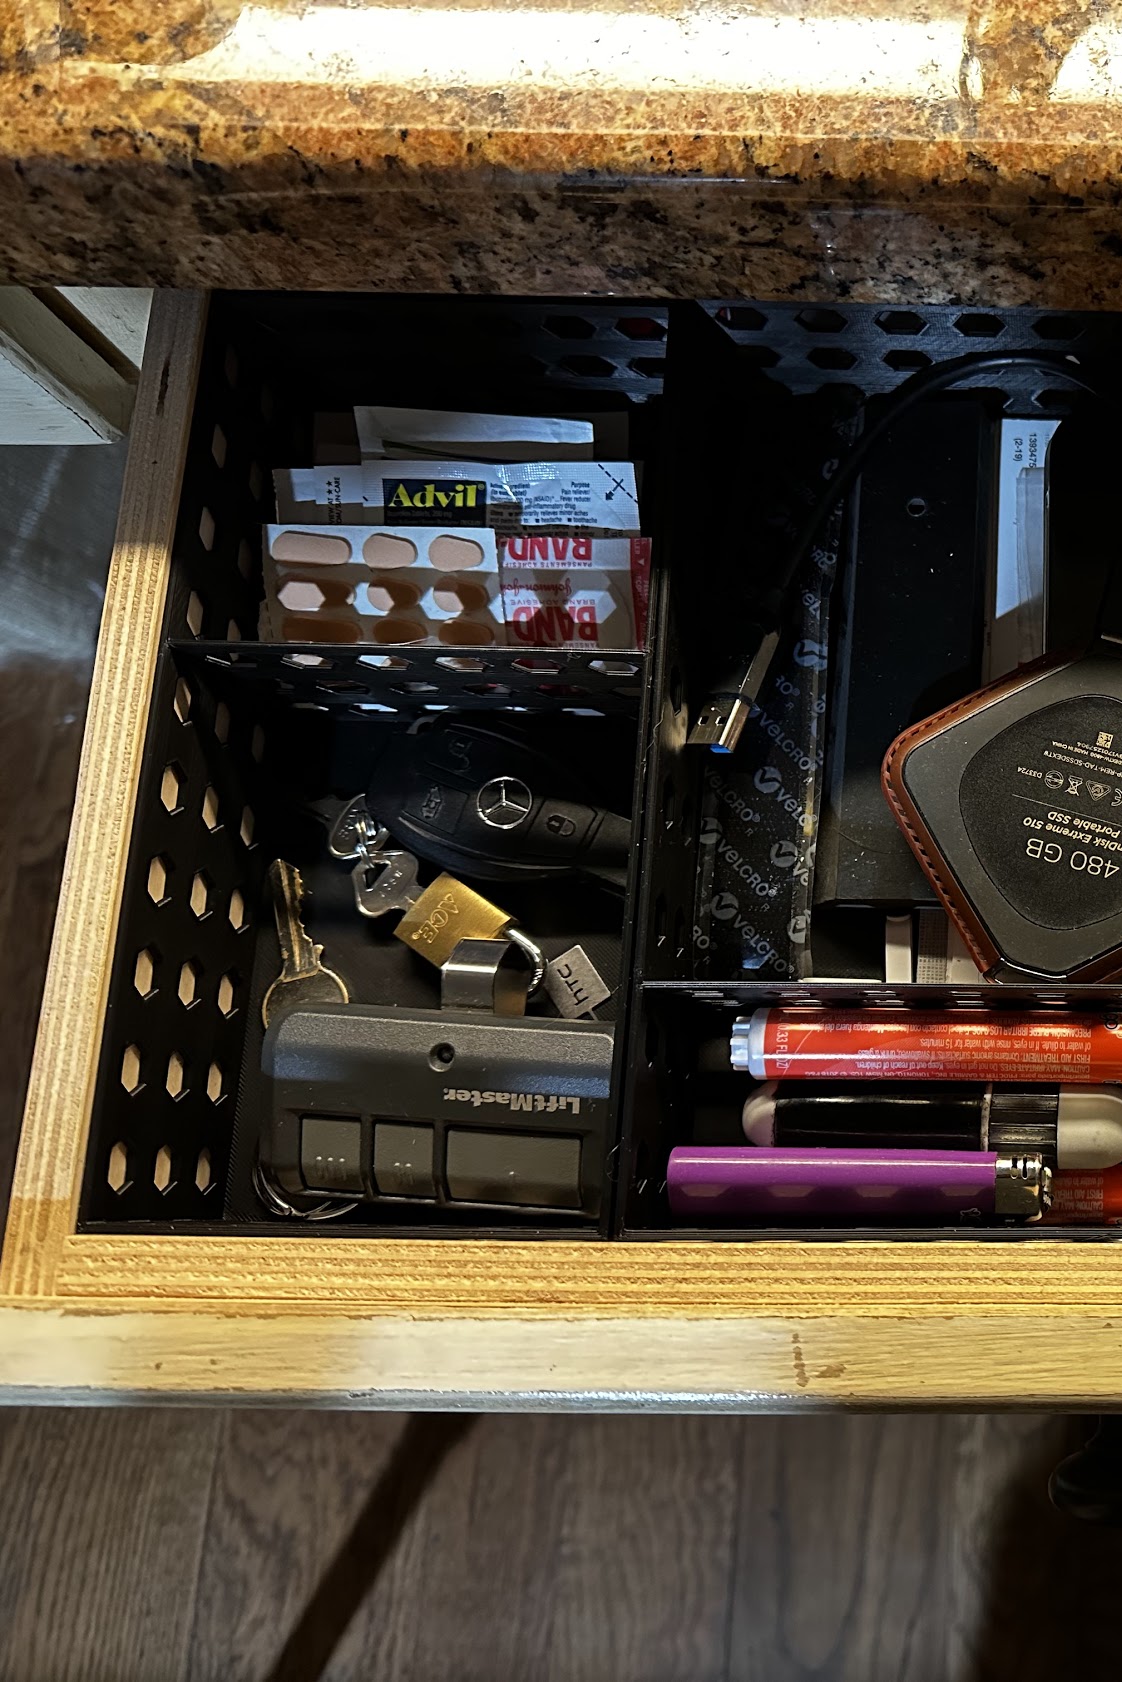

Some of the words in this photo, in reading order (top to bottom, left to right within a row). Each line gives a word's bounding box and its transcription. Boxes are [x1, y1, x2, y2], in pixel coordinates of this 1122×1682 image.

[1013, 438, 1023, 462] (2-19)
[388, 483, 478, 508] Advil
[1023, 816, 1044, 830] 510
[1047, 811, 1072, 825] SSD
[1045, 823, 1093, 844] Extreme
[1072, 818, 1121, 839] Portable
[1026, 838, 1063, 864] GB
[1070, 850, 1120, 879] 480
[419, 894, 459, 945] ACE
[557, 964, 589, 1006] htc
[945, 1039, 953, 1049] 15
[955, 1039, 963, 1049] for
[964, 1040, 981, 1050] water
[982, 1040, 995, 1050] with
[1067, 1042, 1083, 1051] water
[890, 1061, 908, 1070] reach
[928, 1060, 943, 1070] Keep
